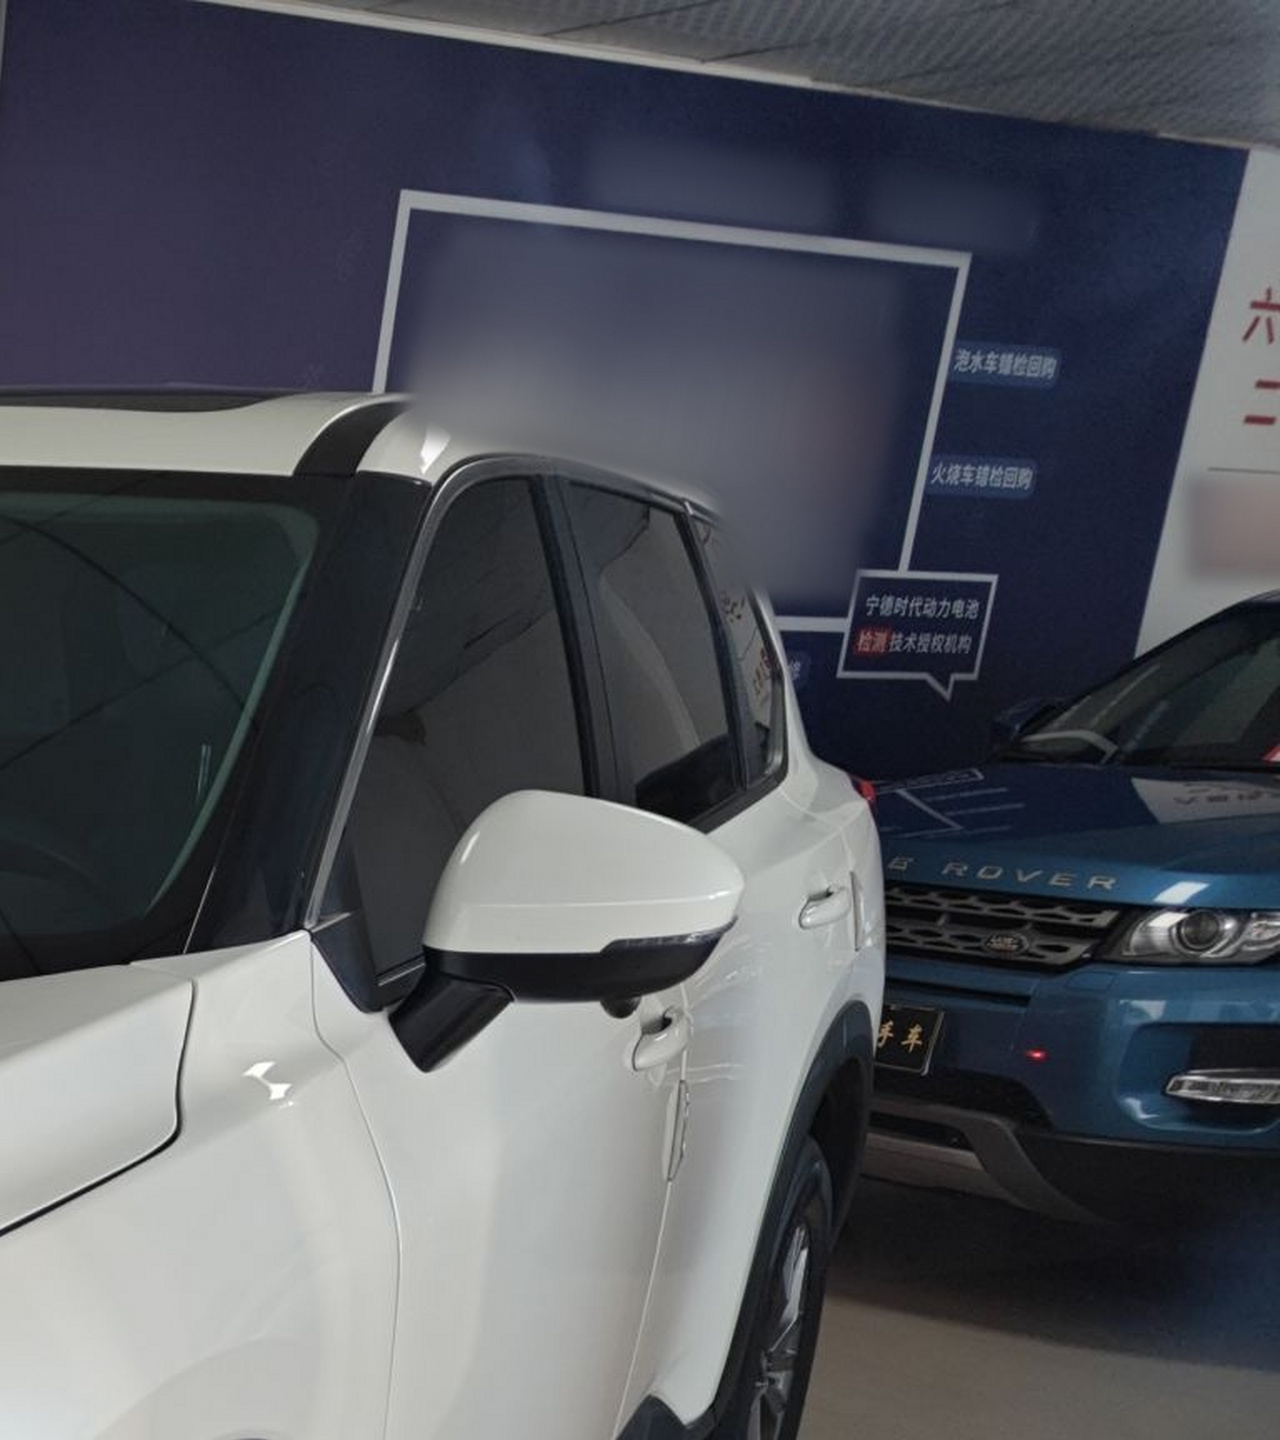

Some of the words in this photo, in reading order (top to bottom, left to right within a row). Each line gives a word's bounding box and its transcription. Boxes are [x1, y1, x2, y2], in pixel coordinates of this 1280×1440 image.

[865, 594, 980, 619] 宁德时代动力电池
[942, 863, 1117, 890] ROVER
